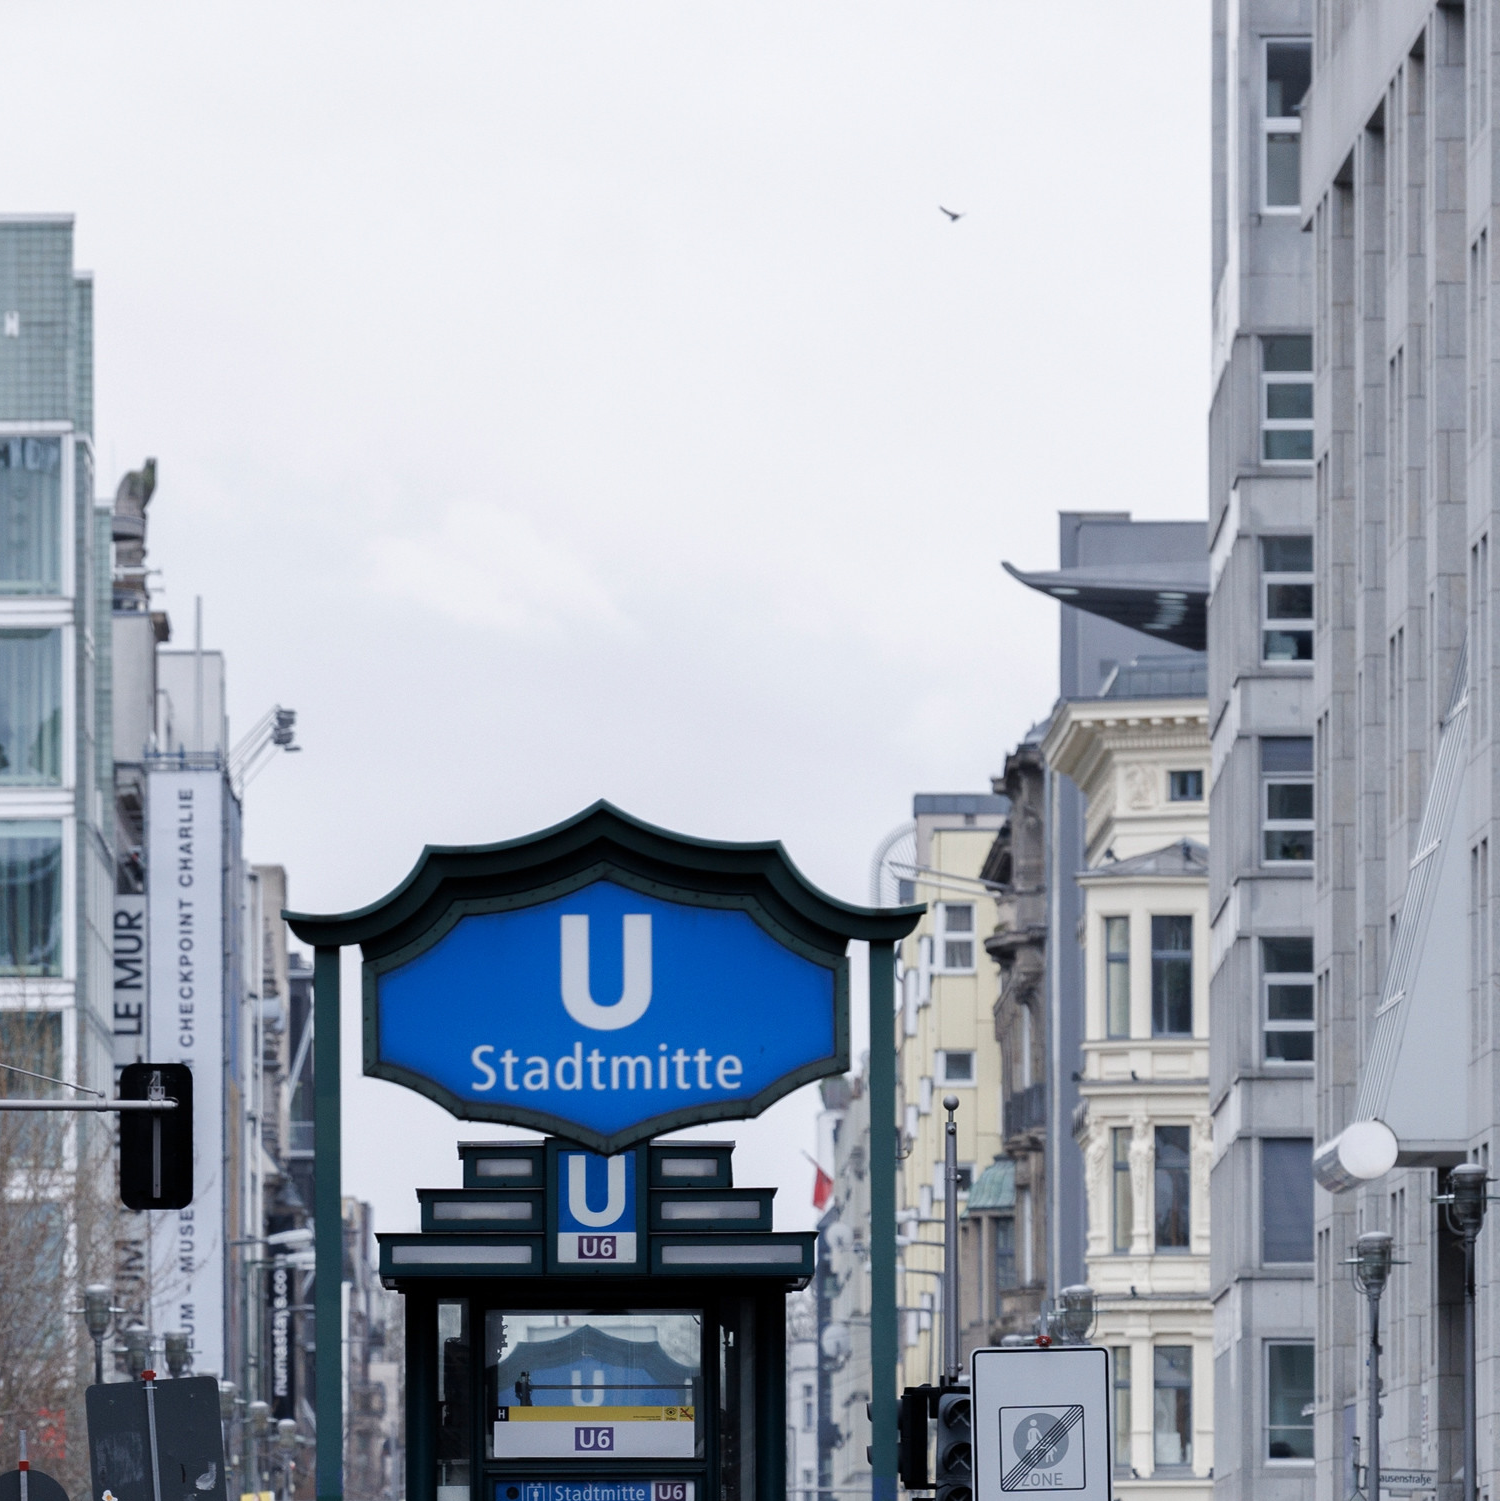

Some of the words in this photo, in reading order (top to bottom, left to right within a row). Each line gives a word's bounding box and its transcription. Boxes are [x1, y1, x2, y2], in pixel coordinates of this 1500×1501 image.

[178, 789, 194, 889] CHARLIE
[113, 909, 143, 991] MUR
[178, 899, 194, 1049] CHECKPOINT
[561, 914, 652, 1030] U
[113, 1002, 143, 1037] LE
[471, 1042, 743, 1091] Stadtmitte
[568, 1155, 625, 1227] U
[582, 1239, 614, 1257] U6
[499, 1410, 505, 1420] H
[579, 1430, 611, 1448] U6
[658, 1484, 684, 1501] U6
[1022, 1472, 1064, 1487] ZONE
